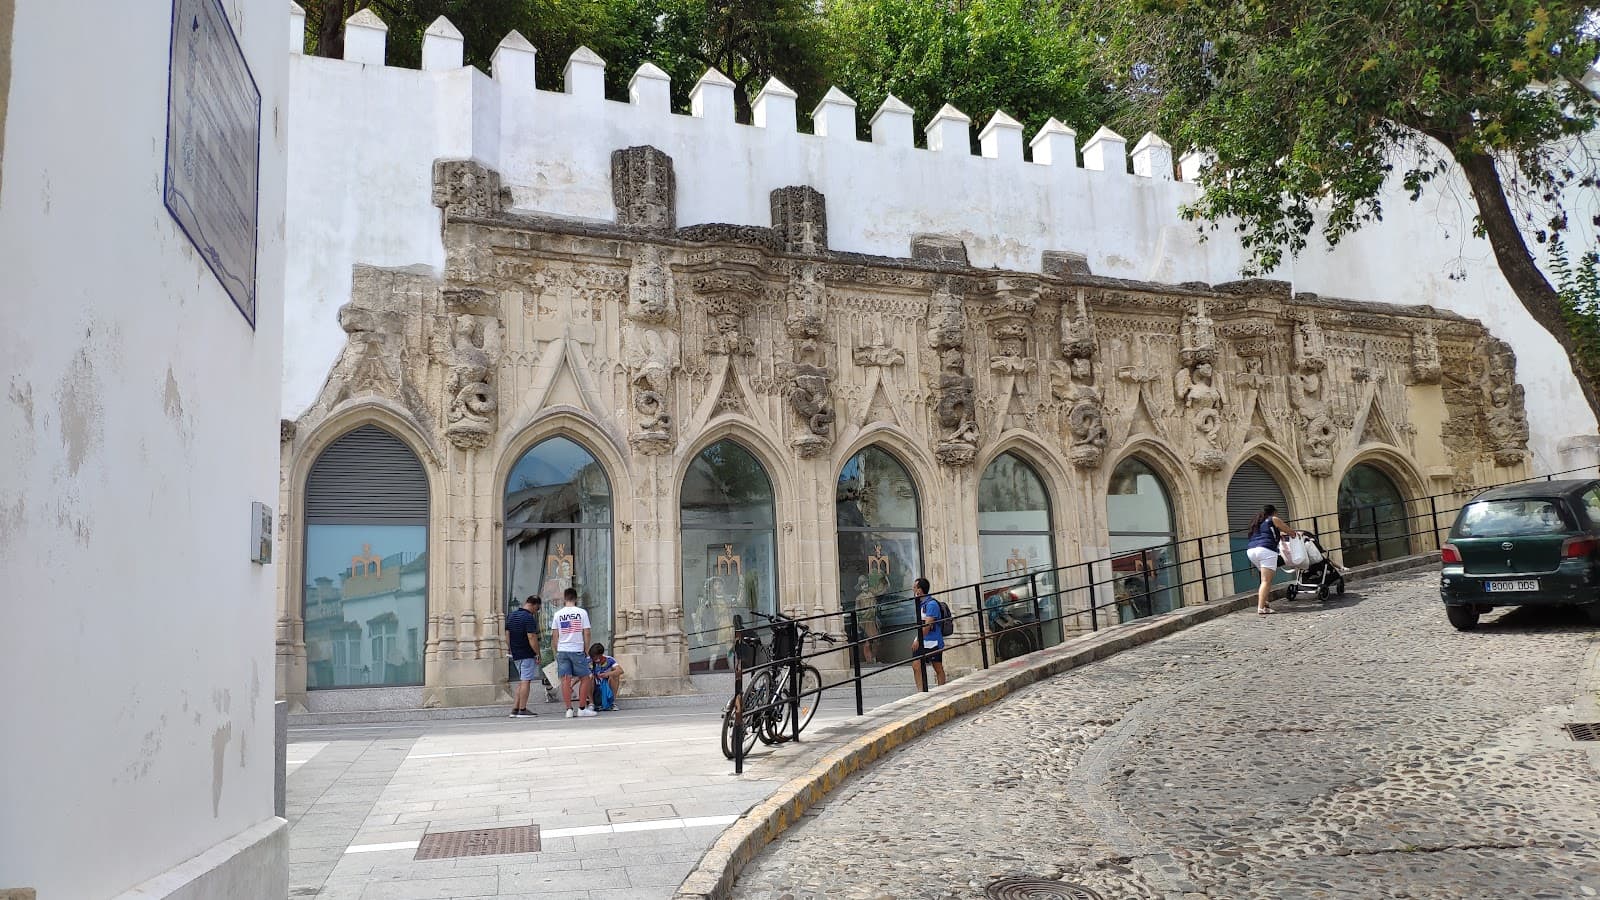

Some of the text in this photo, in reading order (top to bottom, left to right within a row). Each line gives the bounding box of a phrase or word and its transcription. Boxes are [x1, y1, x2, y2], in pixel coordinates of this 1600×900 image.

[1492, 581, 1535, 590] 8000 DDS
[559, 613, 582, 621] NASA
